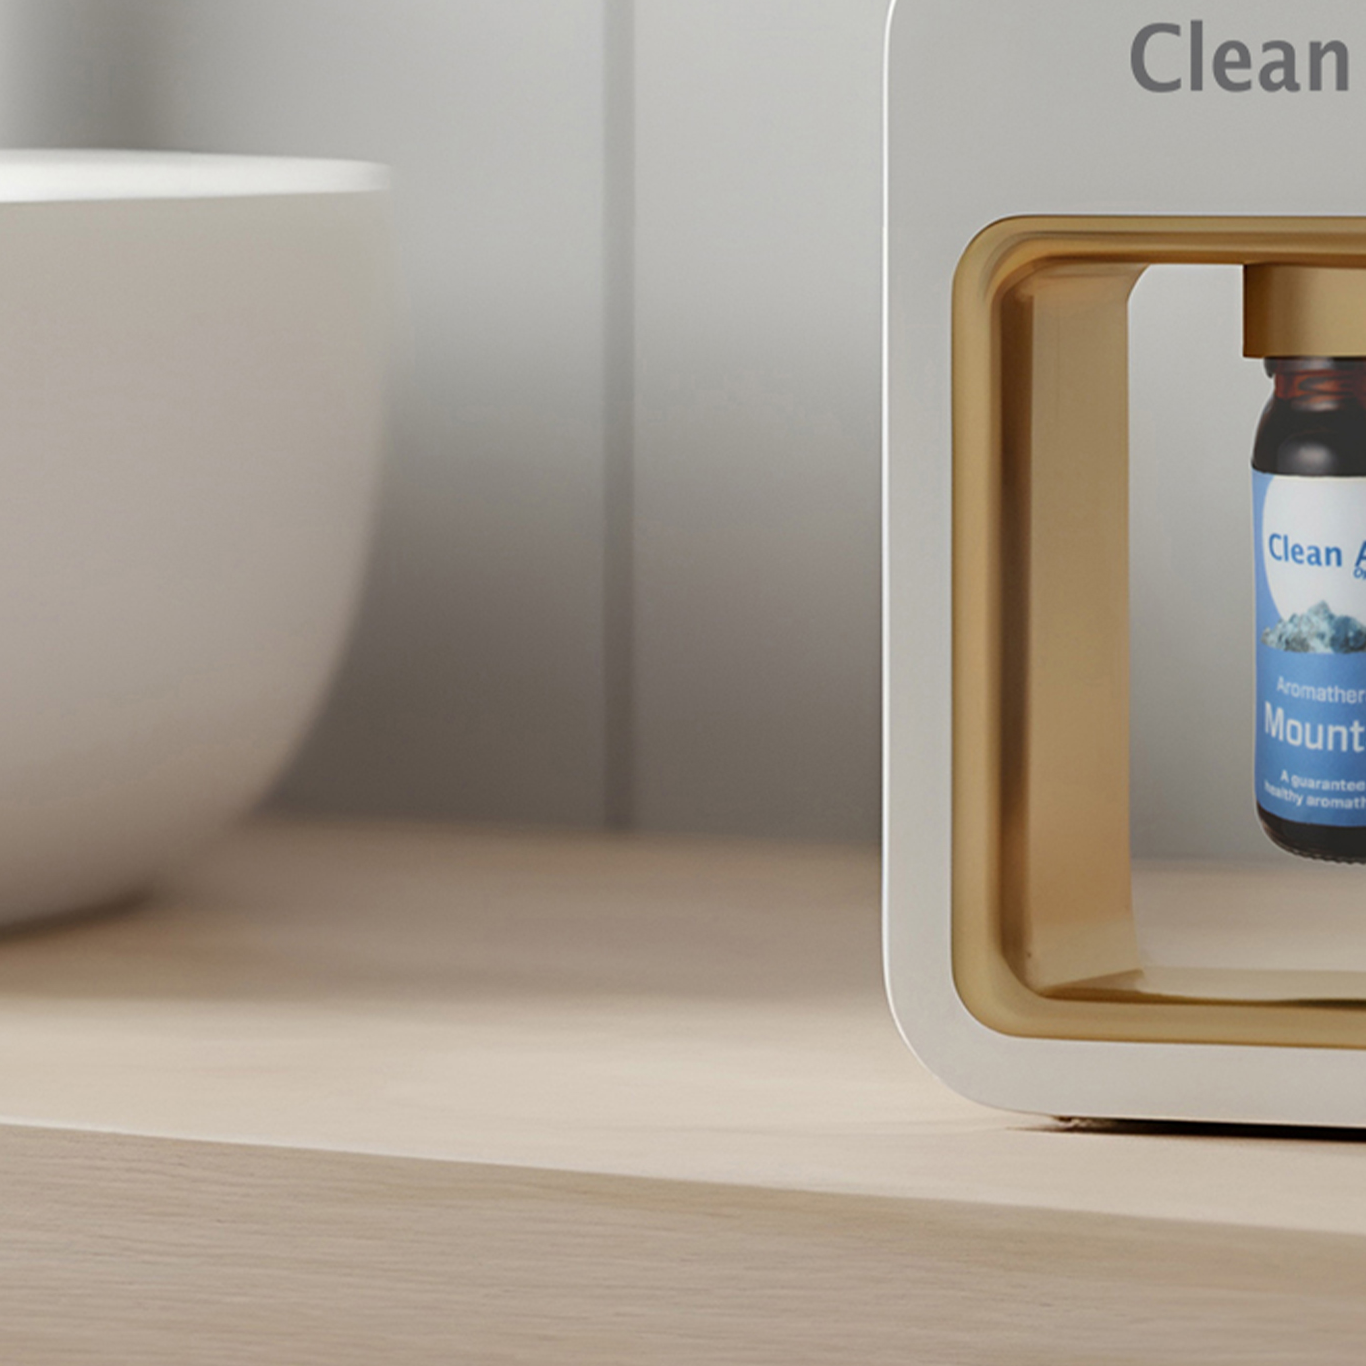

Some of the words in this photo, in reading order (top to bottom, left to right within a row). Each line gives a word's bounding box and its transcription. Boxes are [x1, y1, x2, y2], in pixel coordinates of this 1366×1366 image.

[1130, 19, 1349, 93] Clean
[1268, 532, 1342, 567] Clean
[1280, 770, 1290, 783] A
[1291, 774, 1365, 792] guarantee
